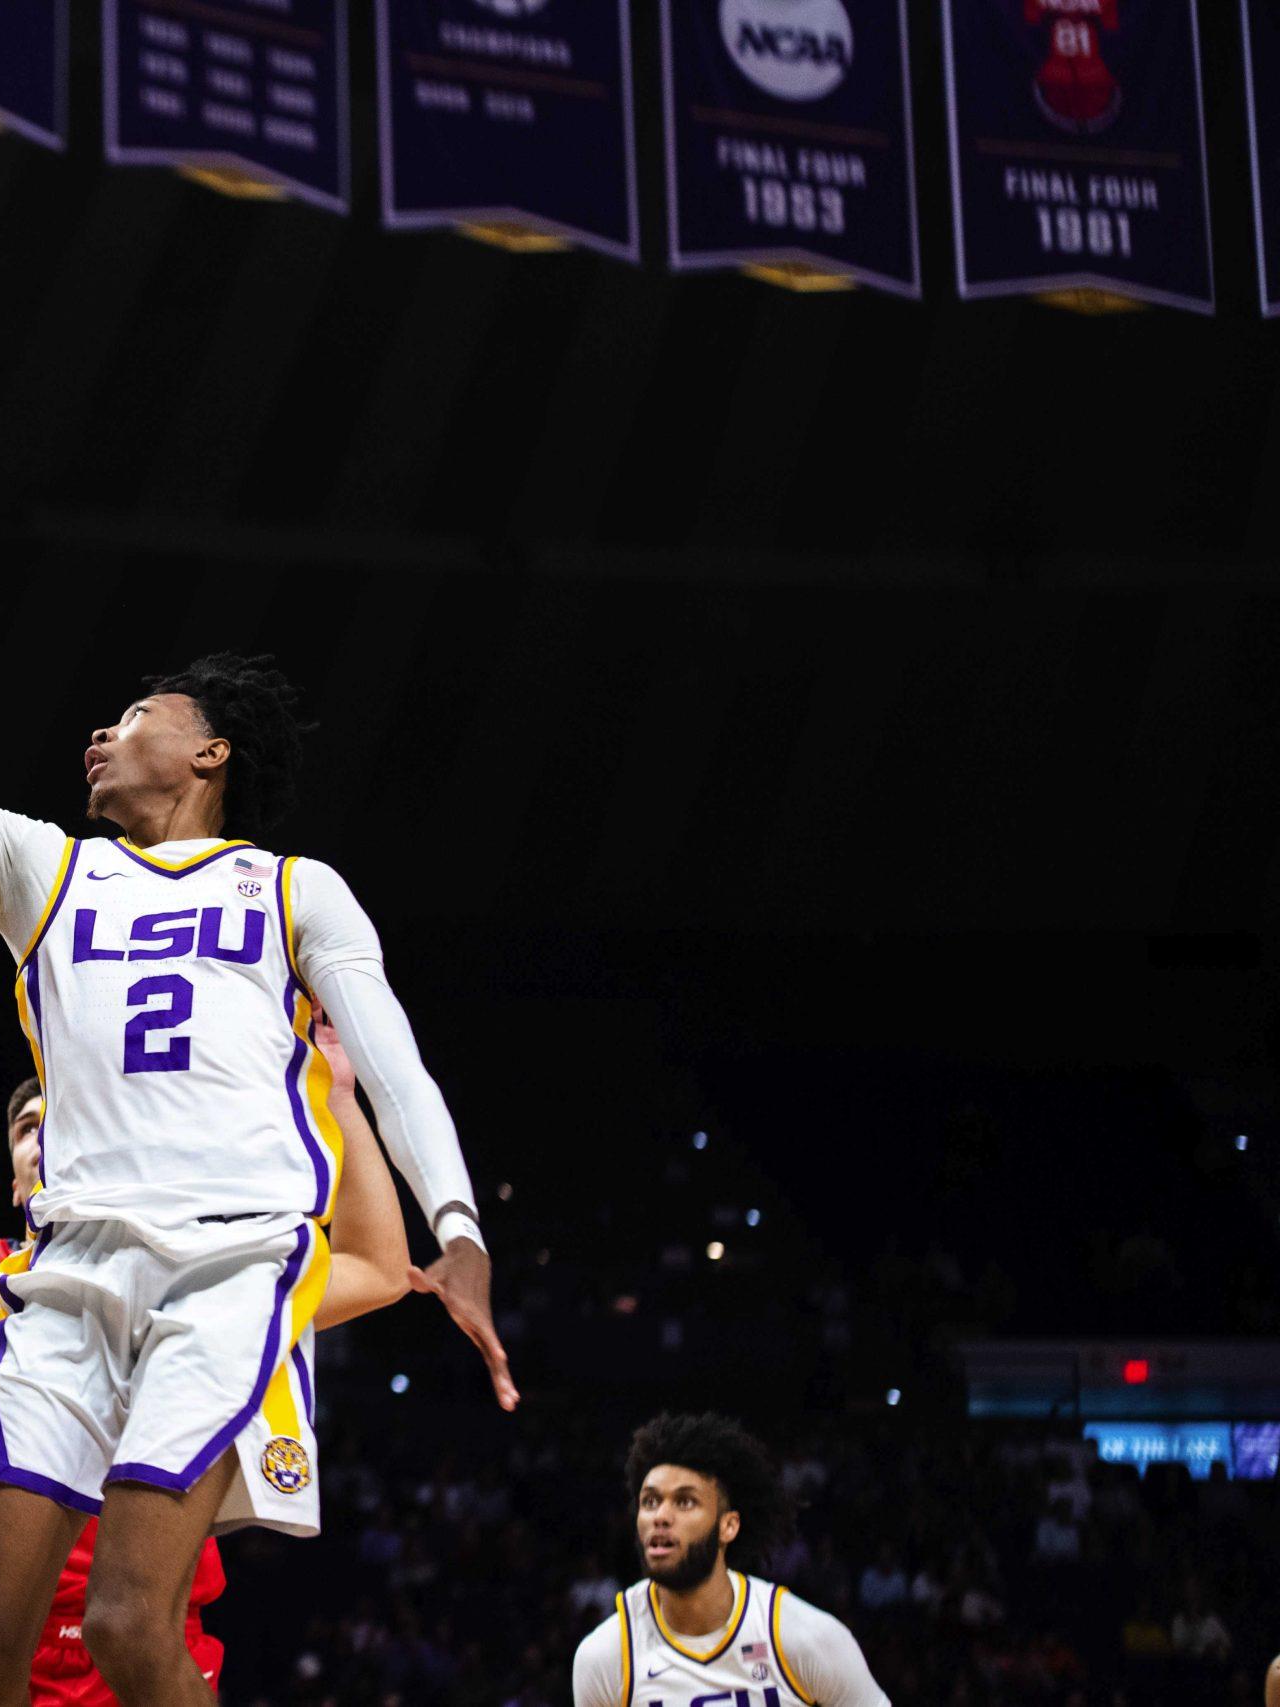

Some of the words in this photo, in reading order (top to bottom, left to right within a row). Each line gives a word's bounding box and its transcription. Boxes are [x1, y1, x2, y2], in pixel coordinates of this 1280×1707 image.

[738, 21, 850, 67] NCAA
[716, 136, 786, 178] FINAL
[797, 148, 865, 188] FOUR
[1004, 166, 1078, 204] FINAL
[1088, 173, 1158, 212] FOUR
[238, 881, 261, 897] SEC
[72, 907, 265, 965] LSU
[124, 974, 194, 1075] 2
